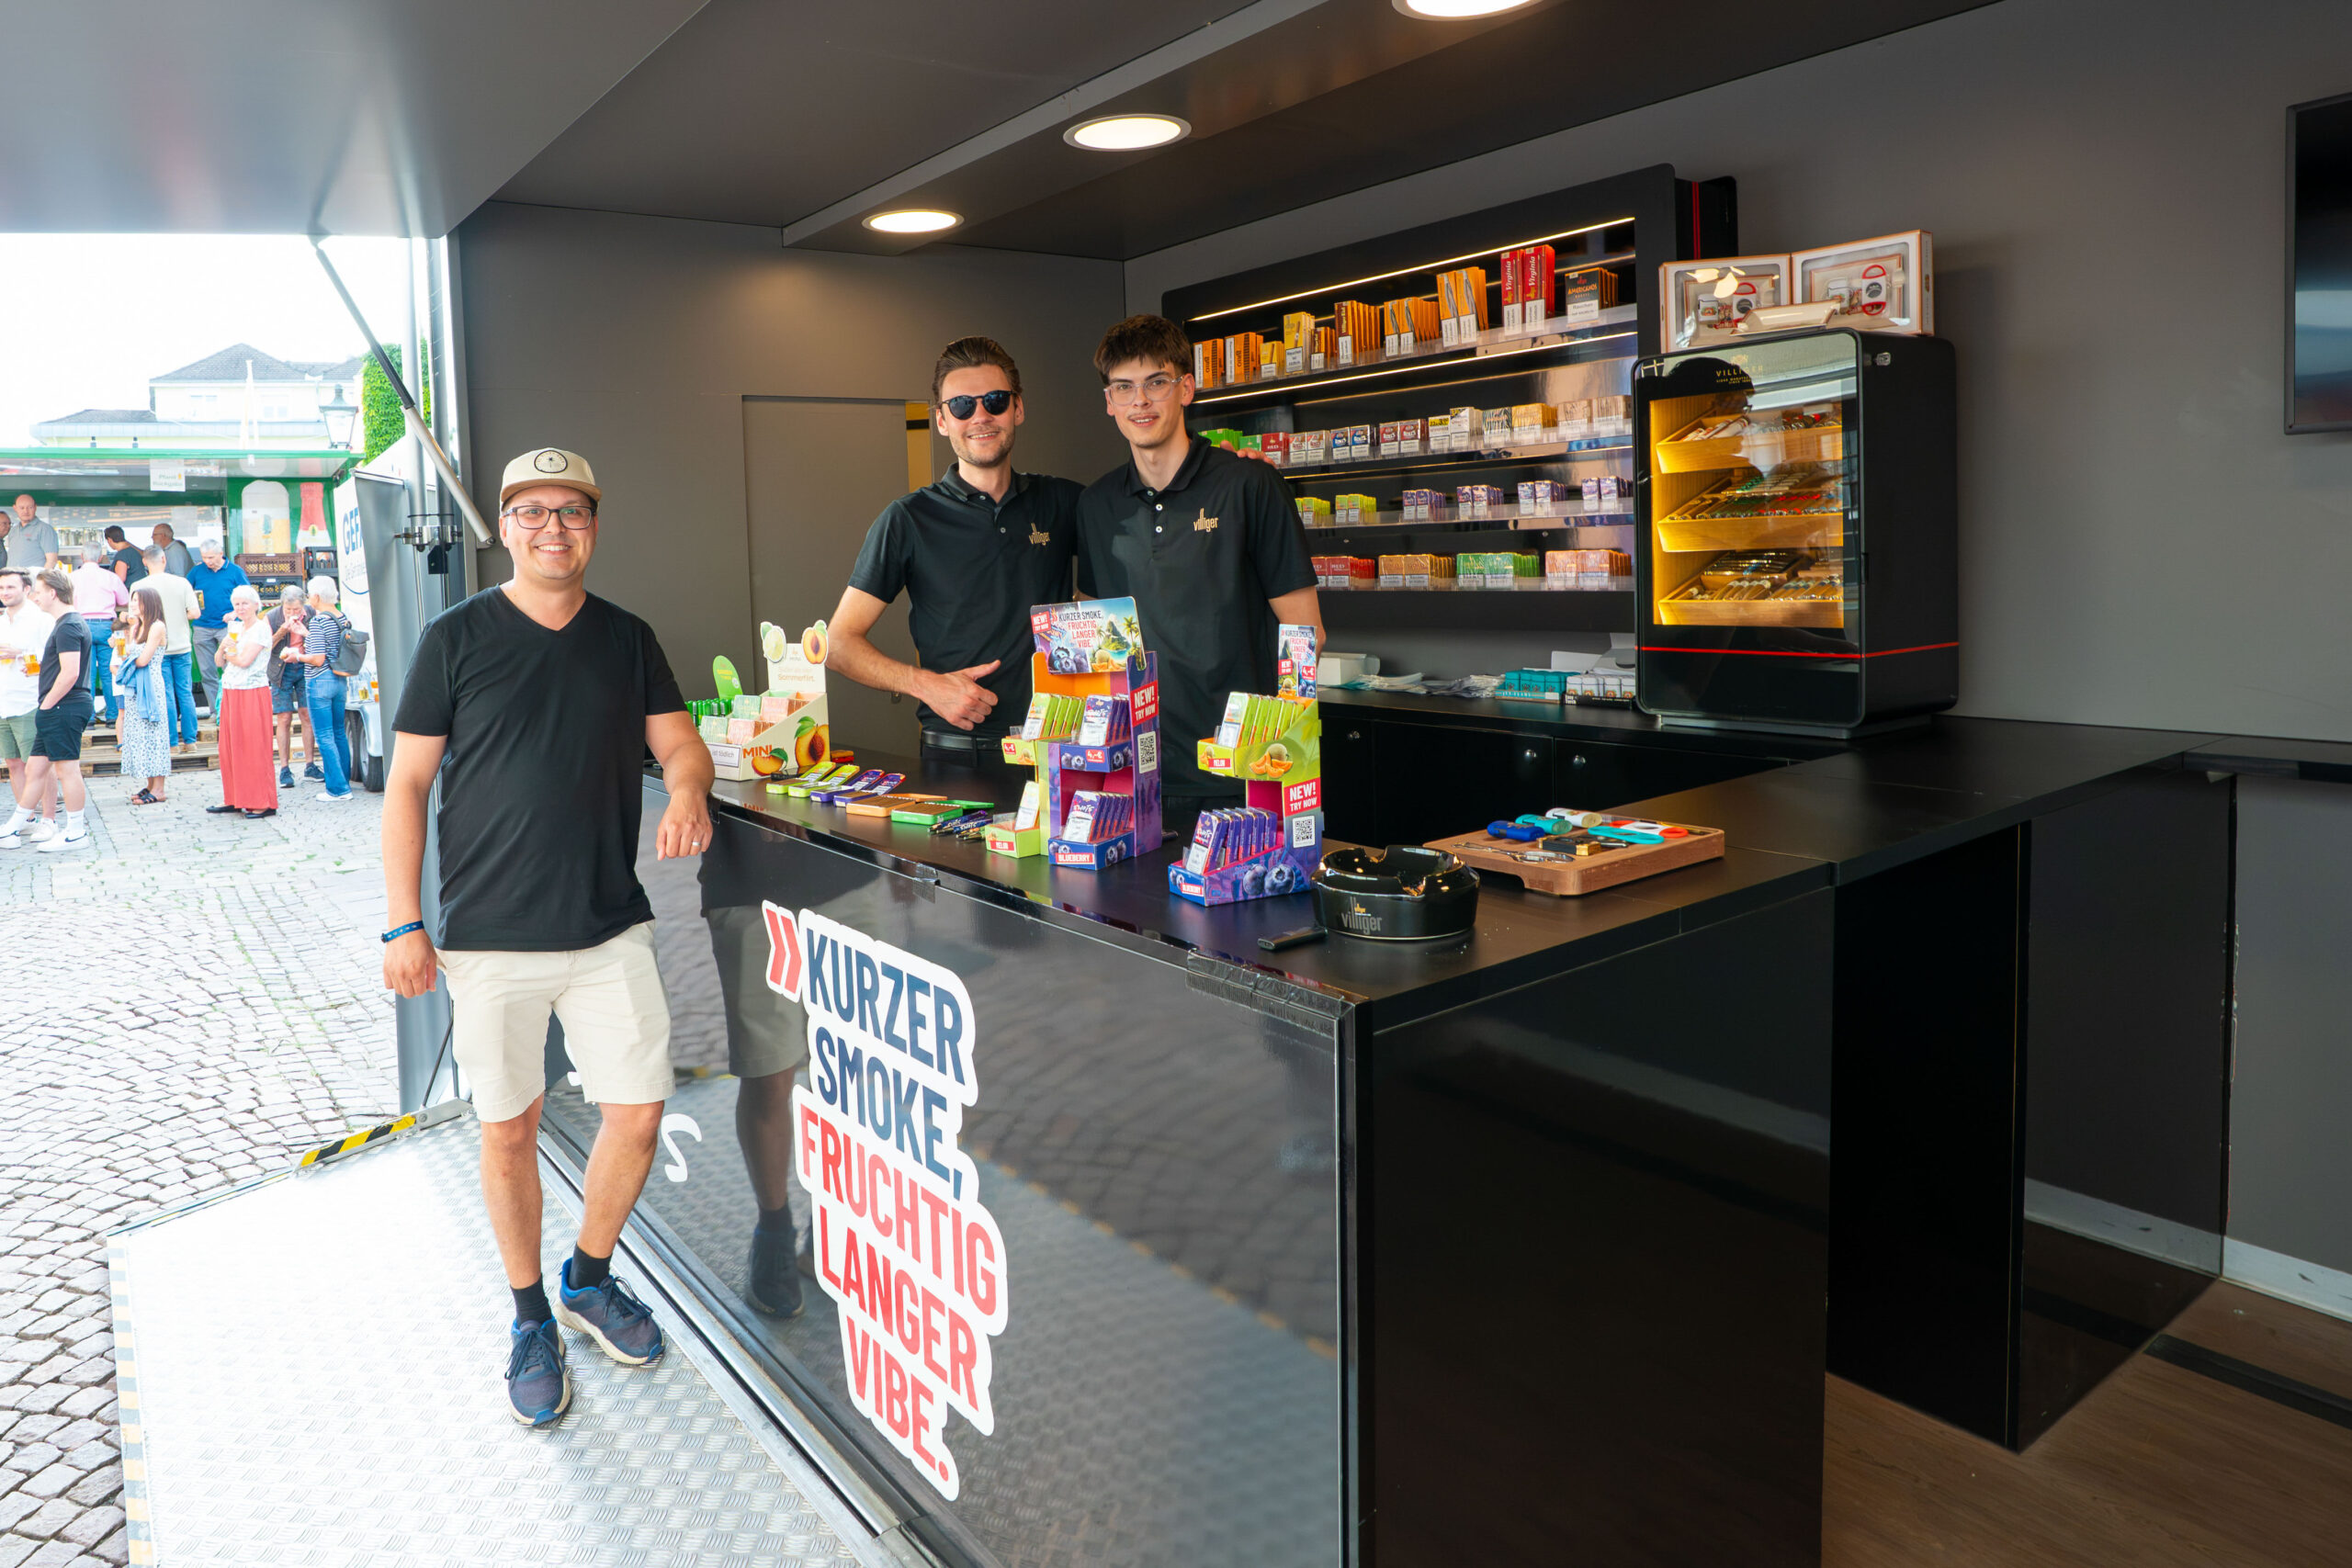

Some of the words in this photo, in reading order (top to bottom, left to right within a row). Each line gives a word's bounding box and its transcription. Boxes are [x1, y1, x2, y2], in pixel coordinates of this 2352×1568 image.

[1529, 256, 1538, 287] Virginia
[1567, 283, 1598, 295] AMERICANOS
[1715, 365, 1763, 377] VILLIGER
[1193, 507, 1219, 533] villiger
[1033, 615, 1047, 626] NEW!
[1058, 612, 1081, 622] KURZER
[1067, 620, 1097, 630] FRUCHTIG
[1072, 630, 1096, 639] LANGER
[1077, 639, 1093, 648] VIBE.
[1134, 684, 1155, 709] NEW!
[1135, 708, 1145, 721] TRY
[1145, 704, 1156, 717] NOW
[718, 750, 734, 758] tödlich
[743, 745, 773, 758] MINI
[1213, 759, 1226, 767] MELON
[1290, 782, 1317, 801] NEW!
[1290, 802, 1301, 812] TRY
[1303, 797, 1317, 807] NOW
[1058, 854, 1091, 863] BLUEBERRY
[1340, 896, 1382, 935] villiger
[806, 928, 965, 1086] KURZER
[815, 1026, 964, 1200] SMOKE,
[800, 1103, 997, 1316] FRUCHTIG
[820, 1206, 979, 1412] LANGER
[847, 1315, 950, 1483] VIBE.
